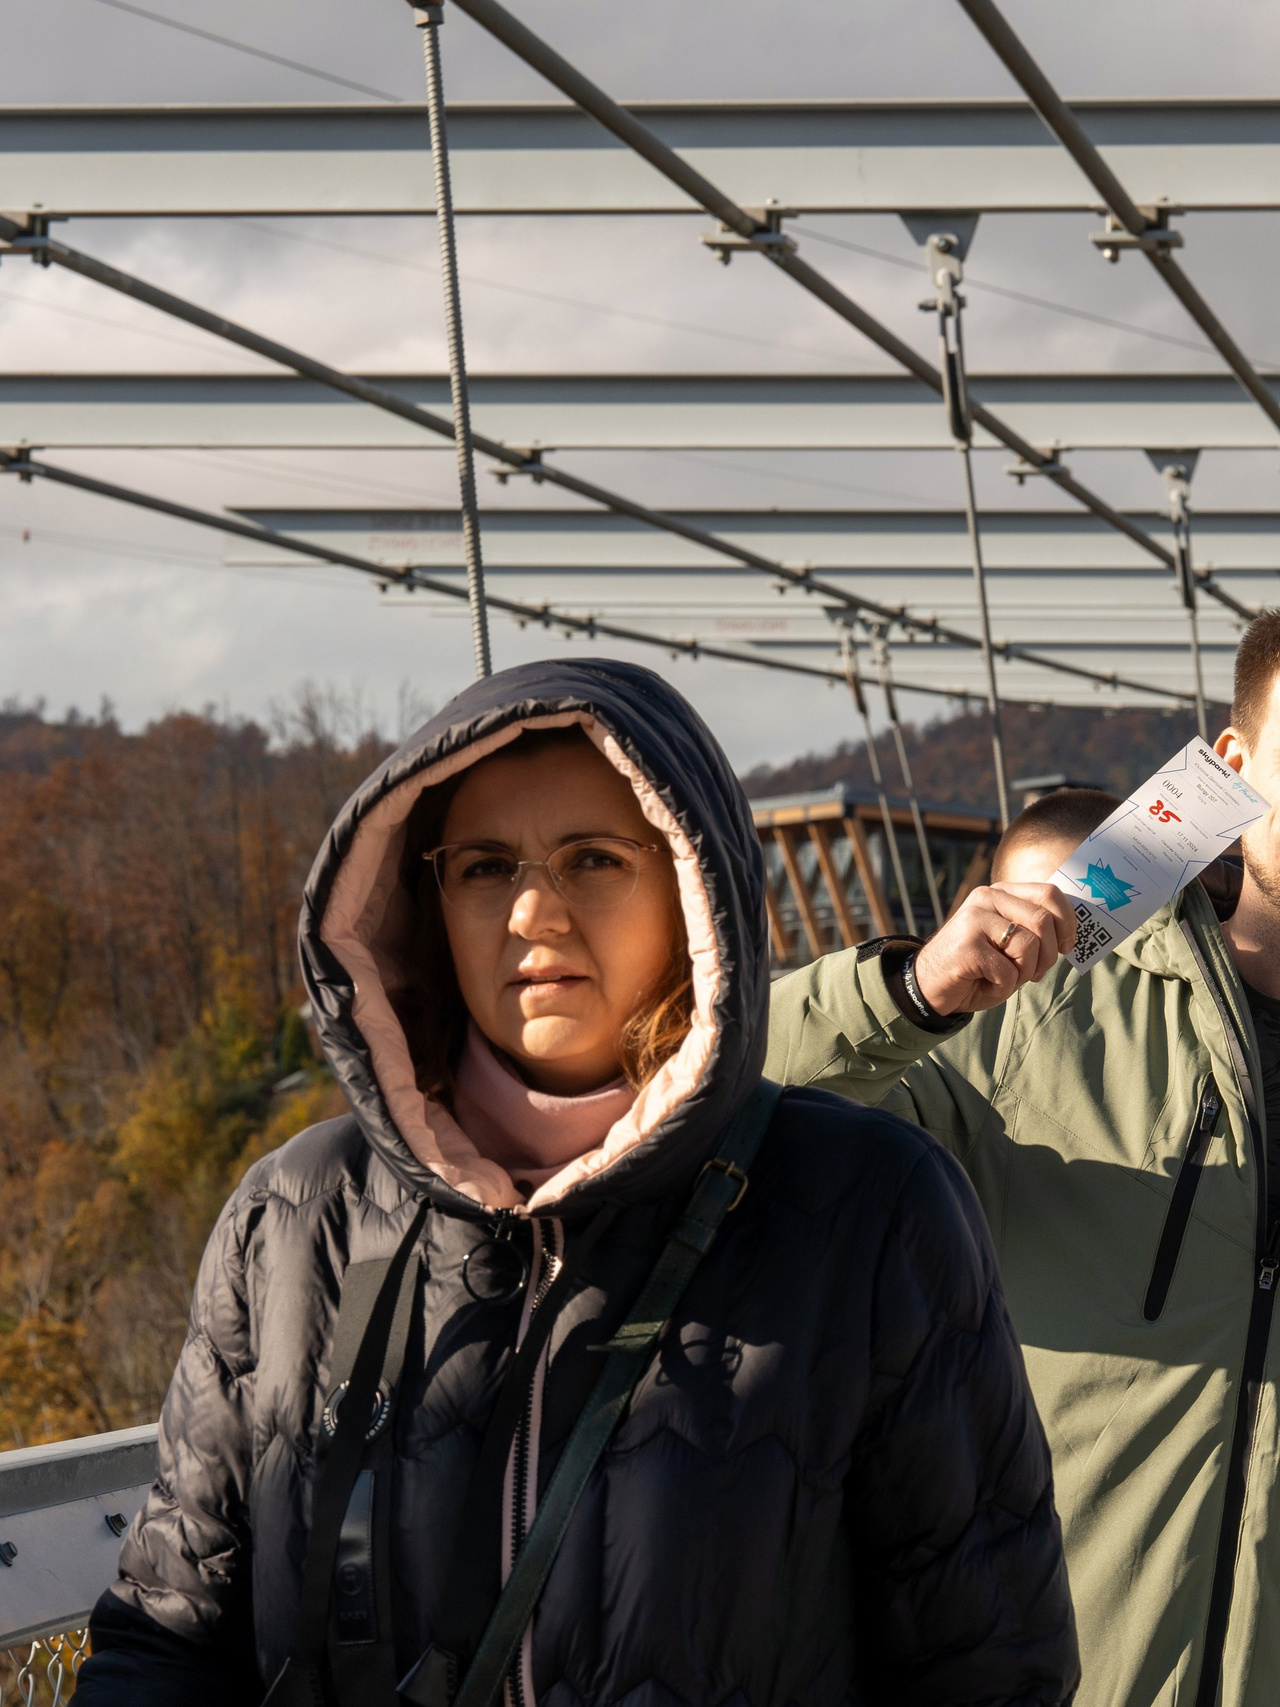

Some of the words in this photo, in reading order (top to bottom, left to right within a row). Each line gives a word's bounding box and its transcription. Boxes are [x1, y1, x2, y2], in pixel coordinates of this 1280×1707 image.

[1197, 748, 1229, 778] skypark!
[1162, 779, 1182, 798] 0004
[1149, 799, 1181, 823] 85
[1176, 831, 1198, 852] 17.11.2024
